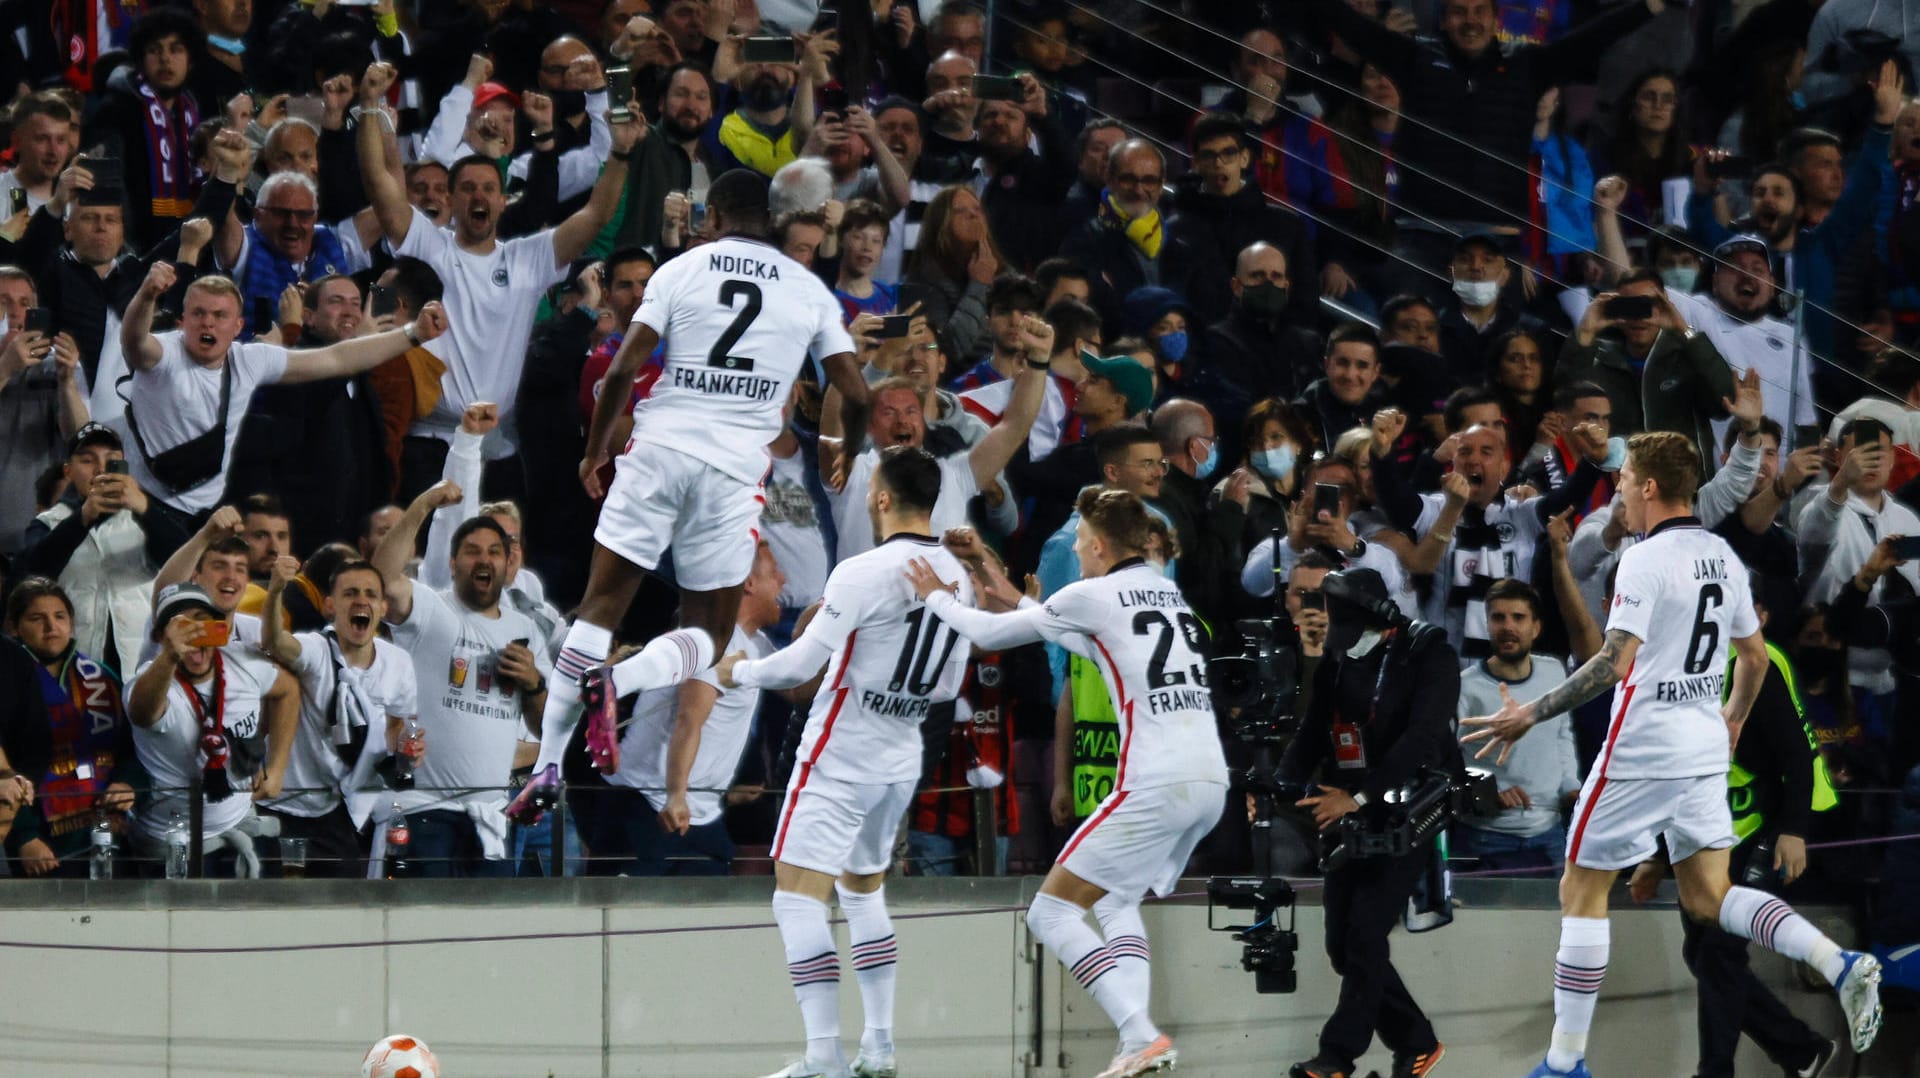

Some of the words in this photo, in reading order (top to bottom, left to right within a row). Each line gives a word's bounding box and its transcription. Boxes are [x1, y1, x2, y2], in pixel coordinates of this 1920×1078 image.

[708, 253, 780, 281] NDICKA
[706, 279, 763, 372] 2
[675, 367, 780, 401] FRANKFURT
[1693, 555, 1728, 580] JAKIĆ
[887, 606, 960, 697] 10
[1683, 583, 1723, 675] 6
